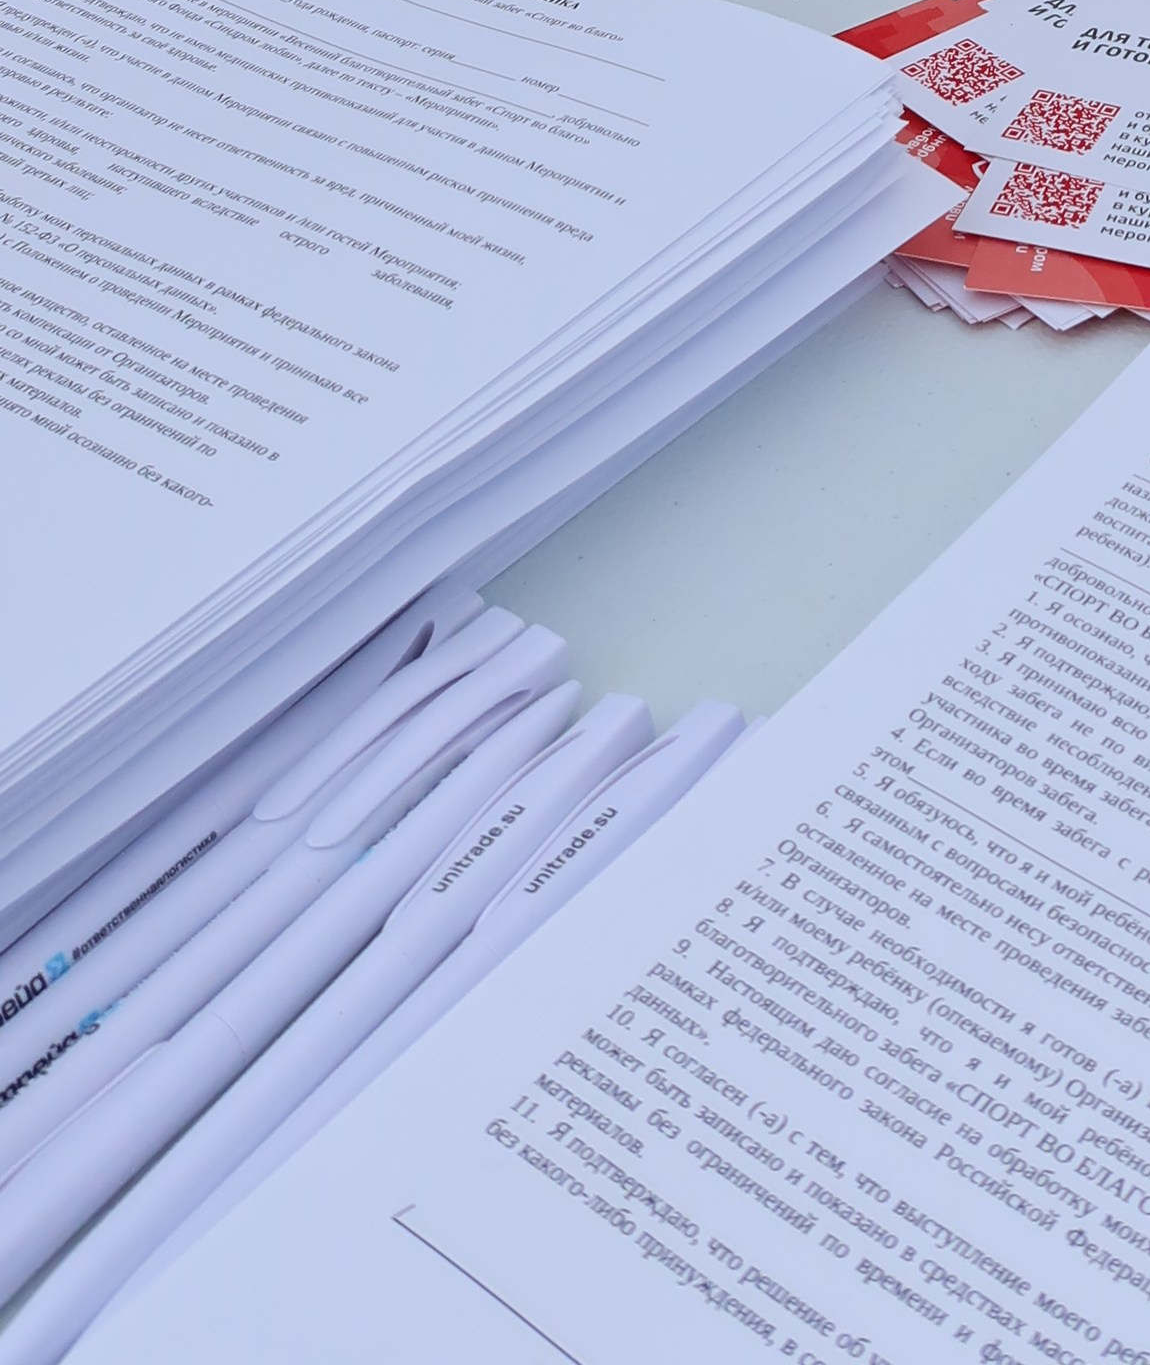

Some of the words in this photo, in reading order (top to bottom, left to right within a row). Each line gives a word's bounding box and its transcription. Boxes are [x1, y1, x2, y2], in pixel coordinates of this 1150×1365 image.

[167, 3, 204, 22] Фонда
[203, 19, 260, 45] «Синдром
[302, 61, 340, 76] далее
[206, 4, 279, 37] мероприятии
[491, 2, 524, 14] забег
[524, 12, 569, 27] «Спорт
[566, 23, 583, 31] во
[583, 26, 623, 43] благо»
[1071, 39, 1091, 51] И
[1079, 27, 1131, 44] ДЛЯ
[1118, 132, 1130, 140] в
[1126, 121, 1138, 129] и
[1112, 201, 1123, 210] в
[1118, 189, 1129, 198] и
[941, 674, 1037, 732] вследствие
[958, 657, 1003, 686] ходу
[1006, 684, 1063, 720] забега
[1069, 719, 1094, 737] не
[1099, 736, 1125, 754] по
[1032, 646, 1150, 719] подтверждаю,
[432, 804, 525, 892] unitrade.su
[524, 807, 618, 893] unitrade.su
[622, 984, 709, 1046] данных».
[532, 1072, 644, 1159] материалов.
[552, 1049, 643, 1112] рекламы
[645, 1108, 681, 1140] без
[580, 1027, 646, 1073] может
[644, 1067, 691, 1109] быть
[693, 1104, 785, 1172] записано
[484, 1118, 520, 1149] без
[516, 1143, 636, 1236] какого-либо
[509, 1095, 539, 1124] 11.
[545, 1121, 574, 1142] Я
[564, 1136, 700, 1246] подтверждаю,
